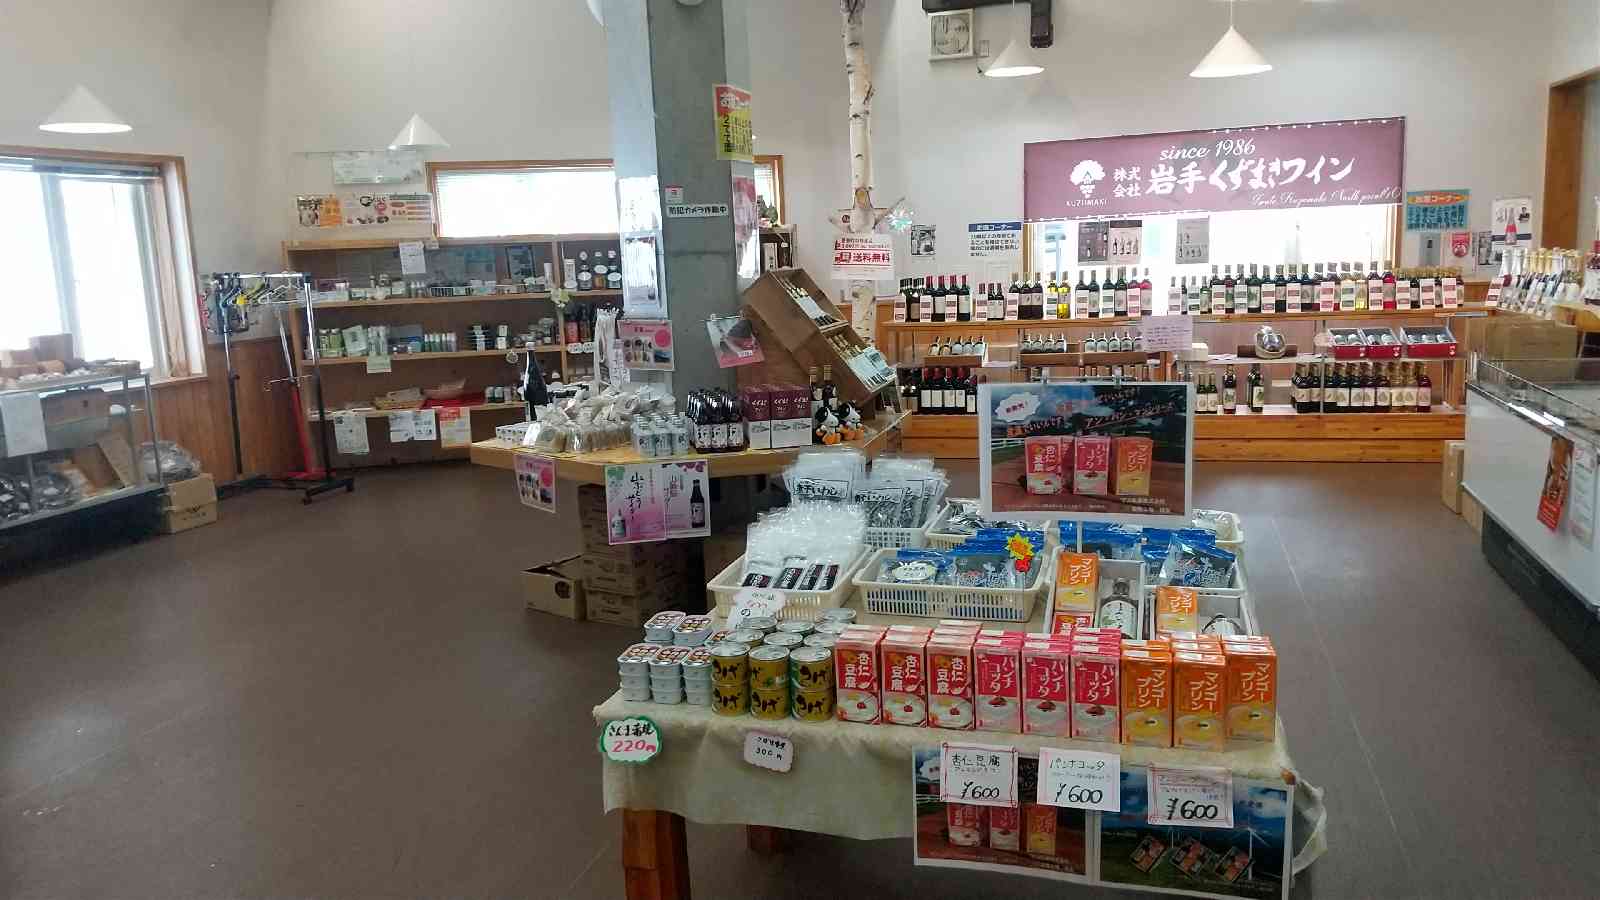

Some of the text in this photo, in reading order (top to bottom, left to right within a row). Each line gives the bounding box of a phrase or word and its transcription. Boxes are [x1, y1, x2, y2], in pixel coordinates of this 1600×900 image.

[1159, 137, 1257, 162] since 1986
[1112, 167, 1142, 182] 株式
[1112, 182, 1142, 198] 会社
[1144, 155, 1356, 196] 岩手くずまきワイン
[1001, 656, 1014, 689] パンナ
[1052, 661, 1065, 692] パンナ
[1102, 665, 1114, 697] パンナ
[1241, 671, 1255, 702] プリン
[1256, 663, 1270, 704] マンゴー
[1137, 676, 1151, 708] プリン
[1151, 669, 1166, 708] マンゴー
[1190, 680, 1205, 711] プリン
[1204, 671, 1219, 711] マンゴー
[612, 740, 657, 752] 220円
[952, 752, 1000, 769] 杏仁豆腐
[1049, 758, 1105, 771] パンナコッタ
[961, 781, 1000, 800] ¥600
[1055, 782, 1104, 805] ¥600
[1167, 797, 1218, 820] ¥600
